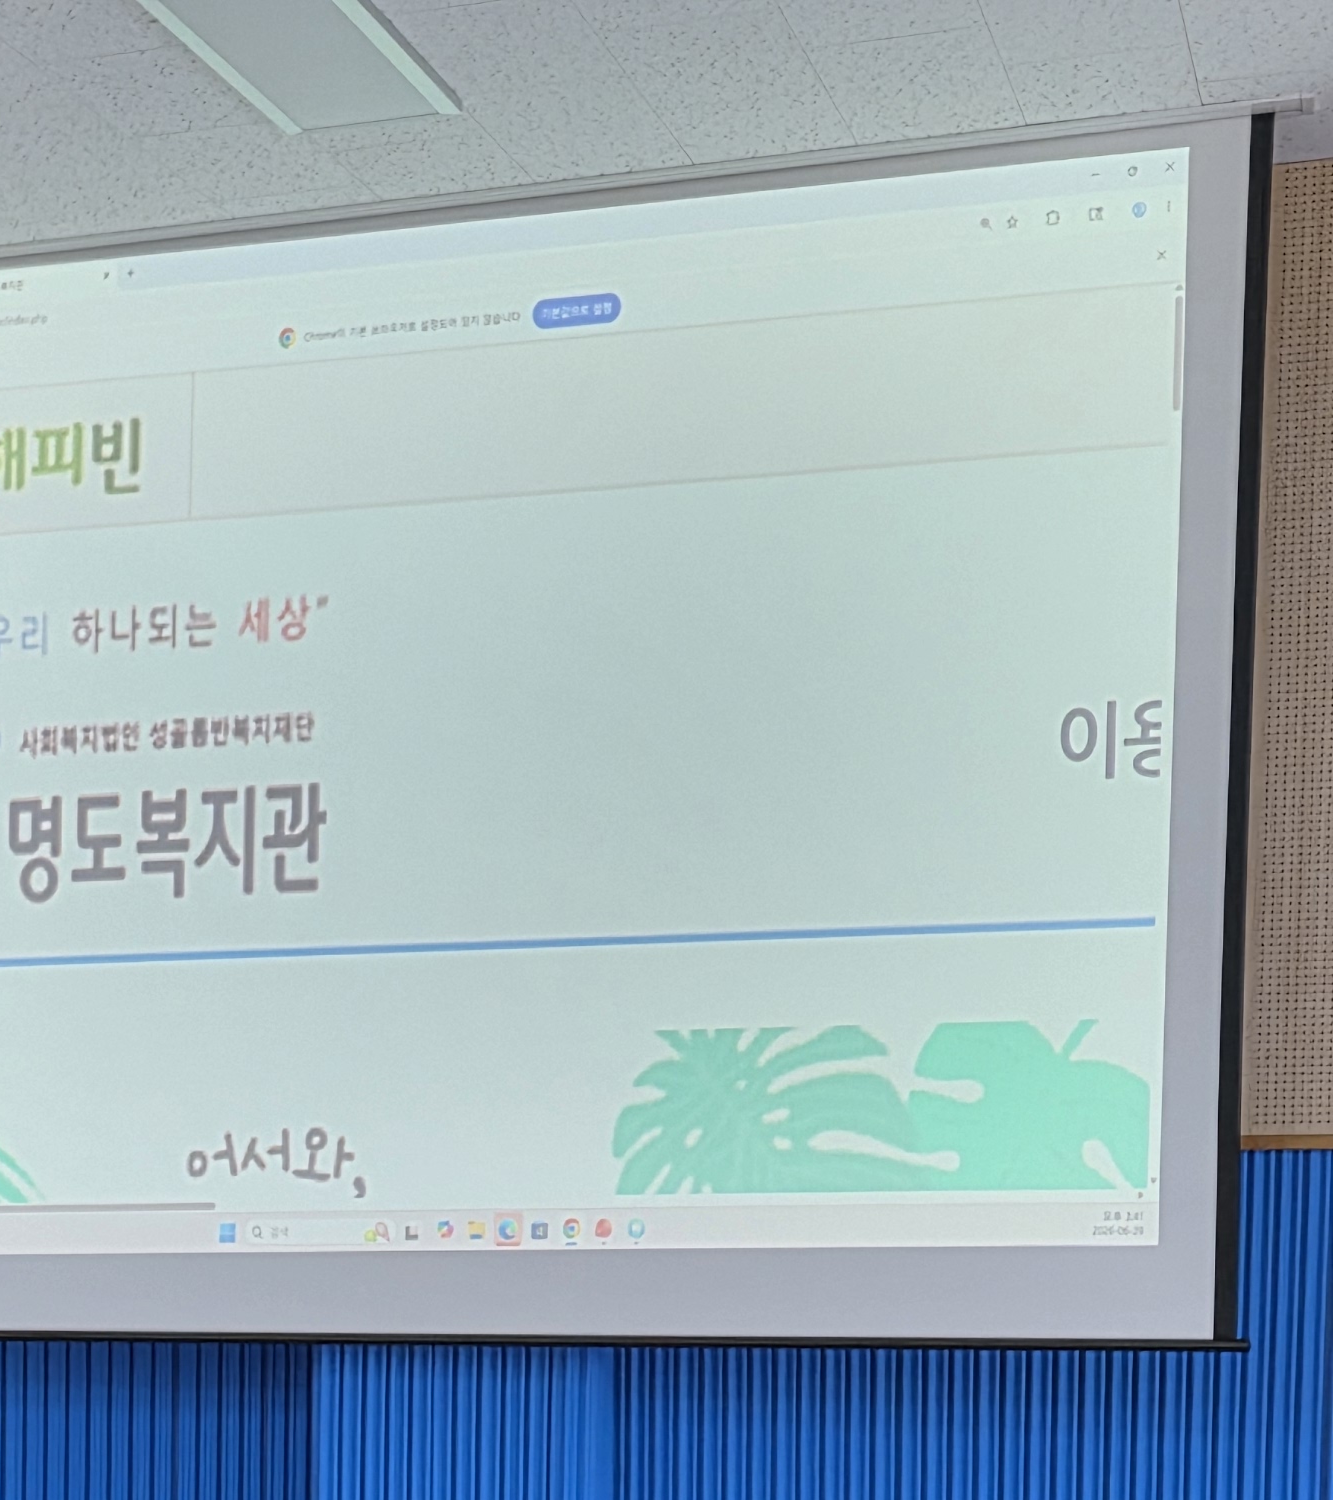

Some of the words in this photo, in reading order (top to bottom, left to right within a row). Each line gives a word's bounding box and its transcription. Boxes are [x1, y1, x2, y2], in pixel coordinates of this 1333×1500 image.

[71, 602, 217, 654] 하나되는
[19, 720, 141, 759] 사회복지법인
[8, 782, 327, 903] 명도복지관
[187, 1127, 367, 1199] 어서와,
